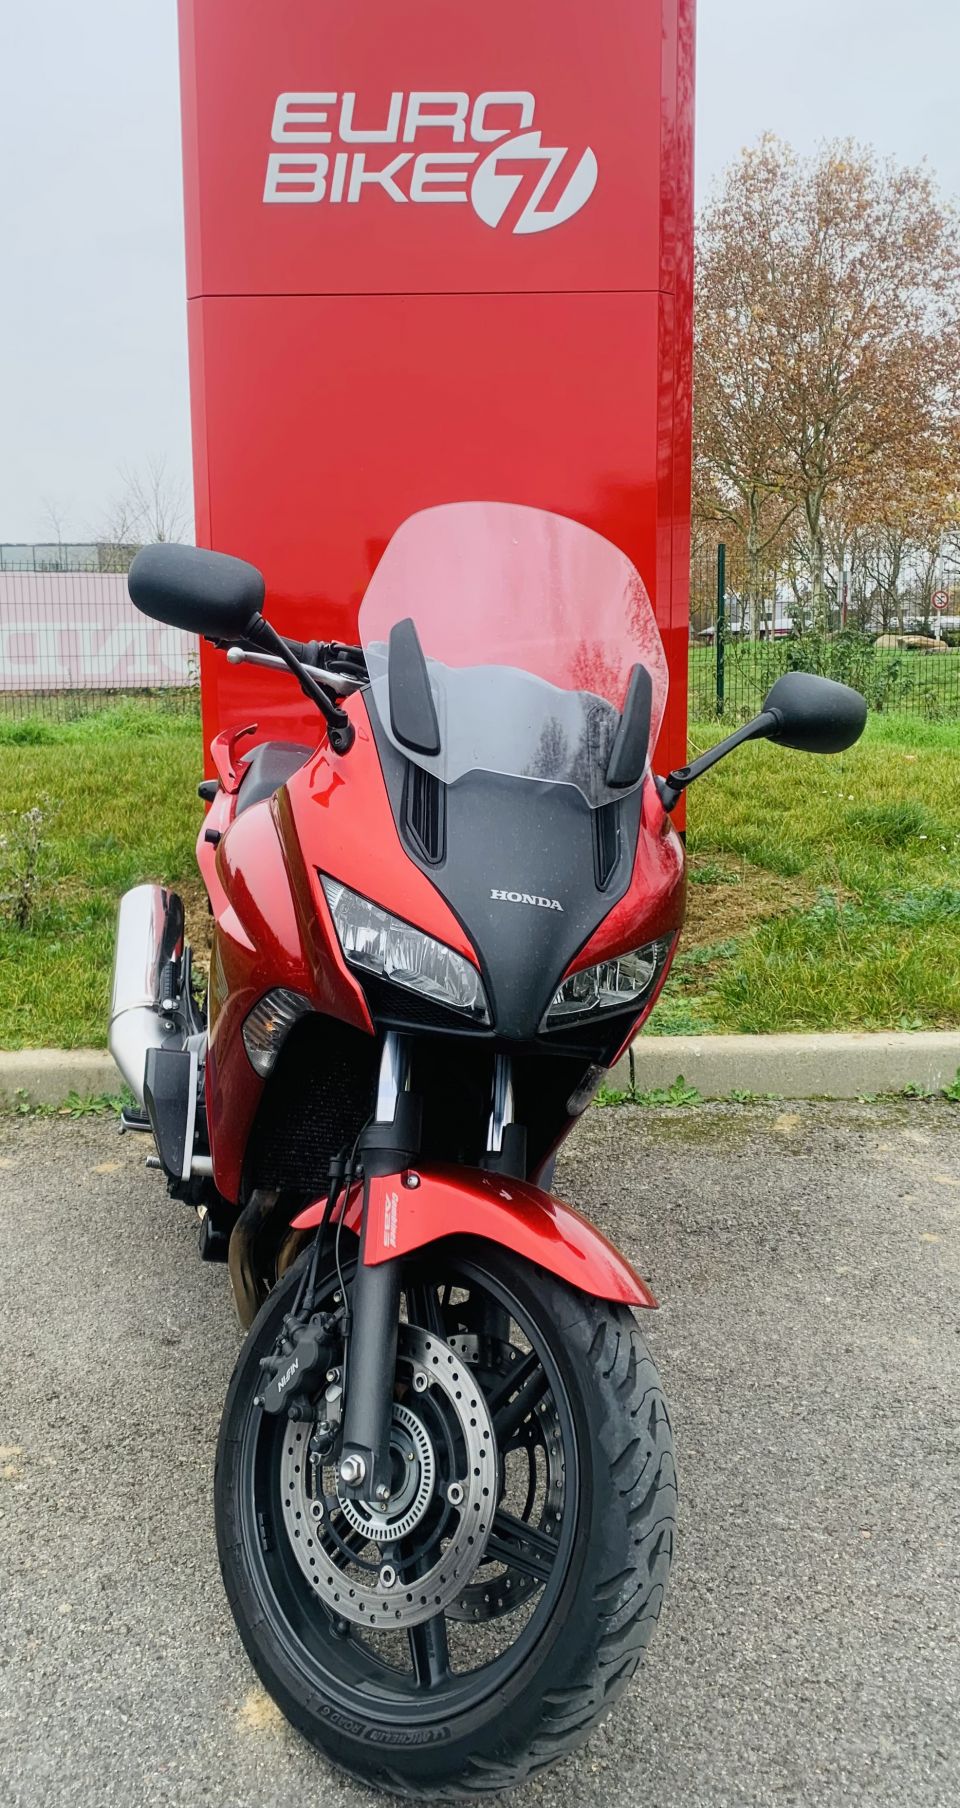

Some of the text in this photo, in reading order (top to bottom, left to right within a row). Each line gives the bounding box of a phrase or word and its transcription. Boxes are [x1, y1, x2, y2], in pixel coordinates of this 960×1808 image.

[271, 91, 536, 143] EURO
[262, 152, 481, 204] BIKE
[490, 888, 564, 912] HONDA
[330, 1714, 363, 1734] ROAD
[370, 1729, 432, 1745] MICHELIN
